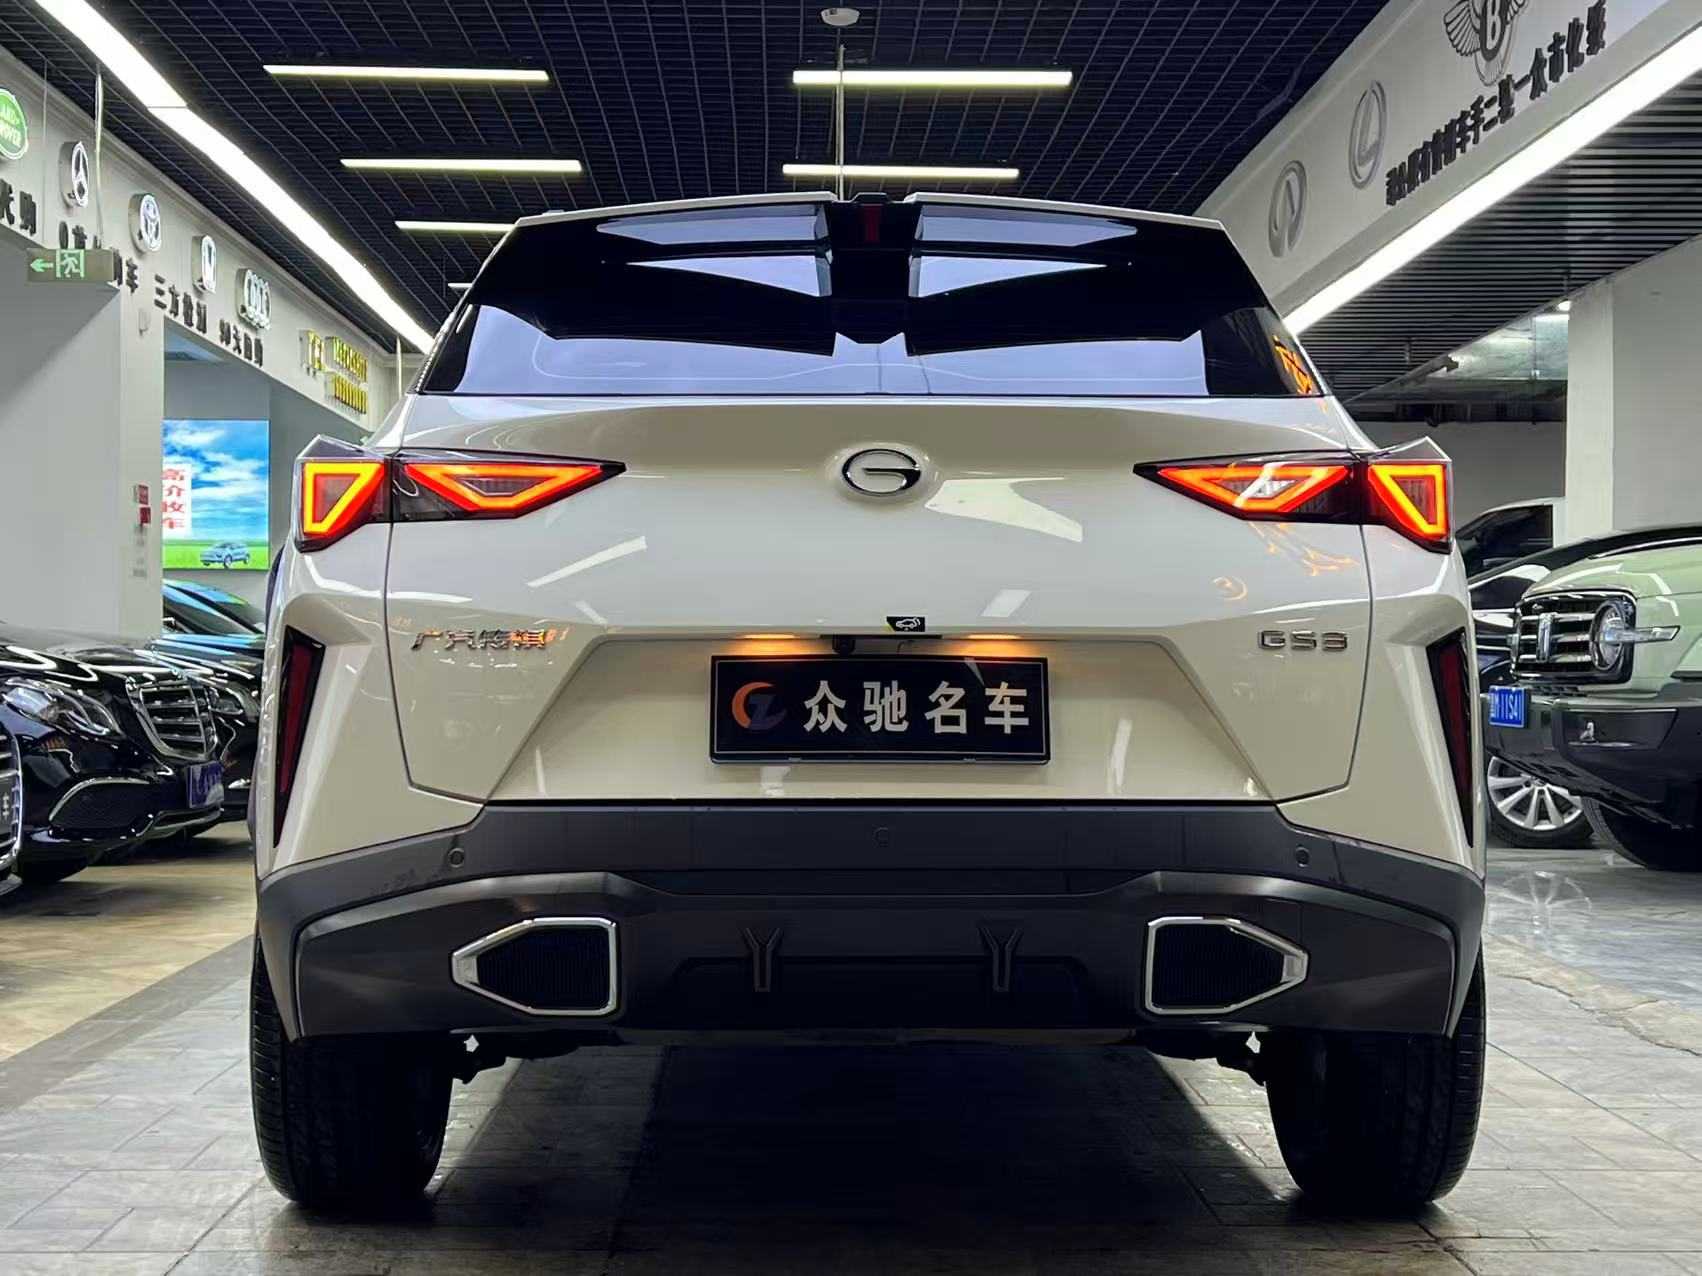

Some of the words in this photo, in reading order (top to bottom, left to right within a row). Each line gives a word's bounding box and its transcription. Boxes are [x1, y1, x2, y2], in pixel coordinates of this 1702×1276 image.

[1257, 630, 1348, 651] GS3
[803, 680, 1030, 734] 众驰名车
